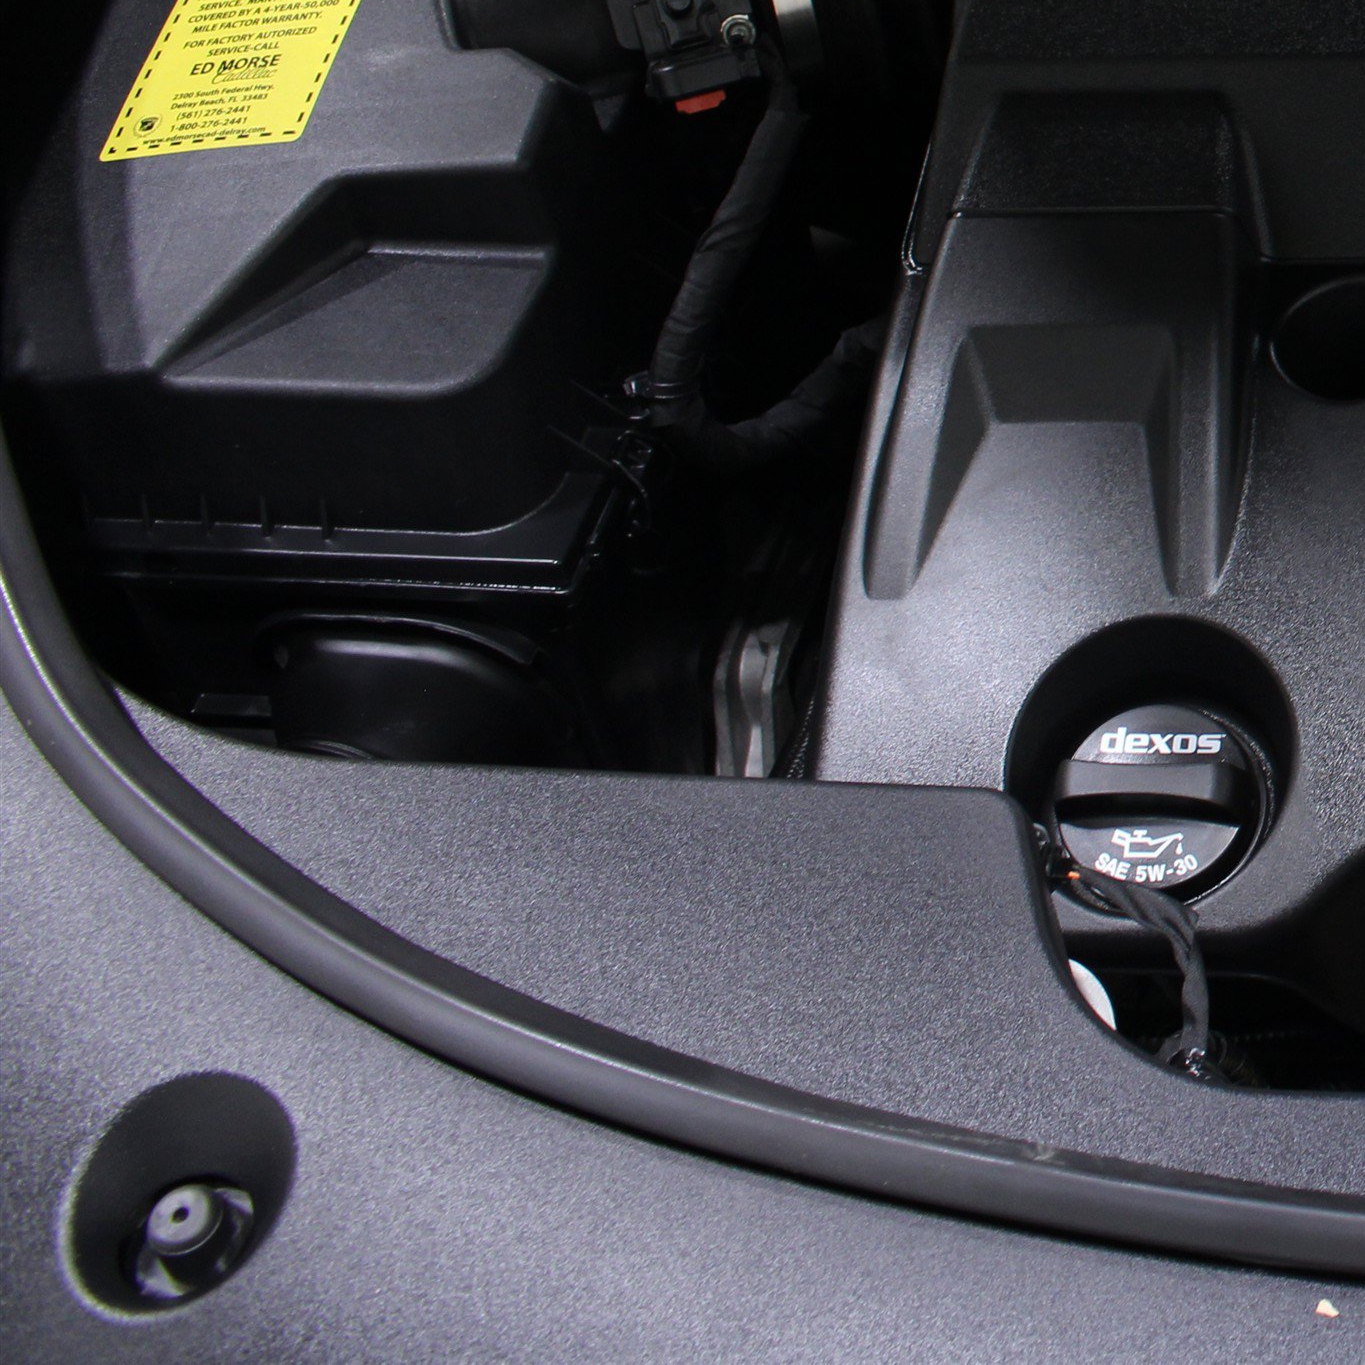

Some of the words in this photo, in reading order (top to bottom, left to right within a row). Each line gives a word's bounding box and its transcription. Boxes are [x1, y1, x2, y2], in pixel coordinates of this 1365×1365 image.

[188, 10, 236, 23] COVERED
[238, 9, 252, 17] BY
[192, 24, 219, 33] MILE
[219, 19, 260, 29] FACTOR
[183, 41, 205, 49] FOR
[206, 34, 255, 46] FACTORY
[255, 27, 317, 39] AUTORIZED
[190, 62, 215, 75] ED
[218, 54, 282, 72] MORSE
[1100, 727, 1223, 755] dexos
[1095, 853, 1131, 880] SAE
[1135, 854, 1198, 882] 5W-30
